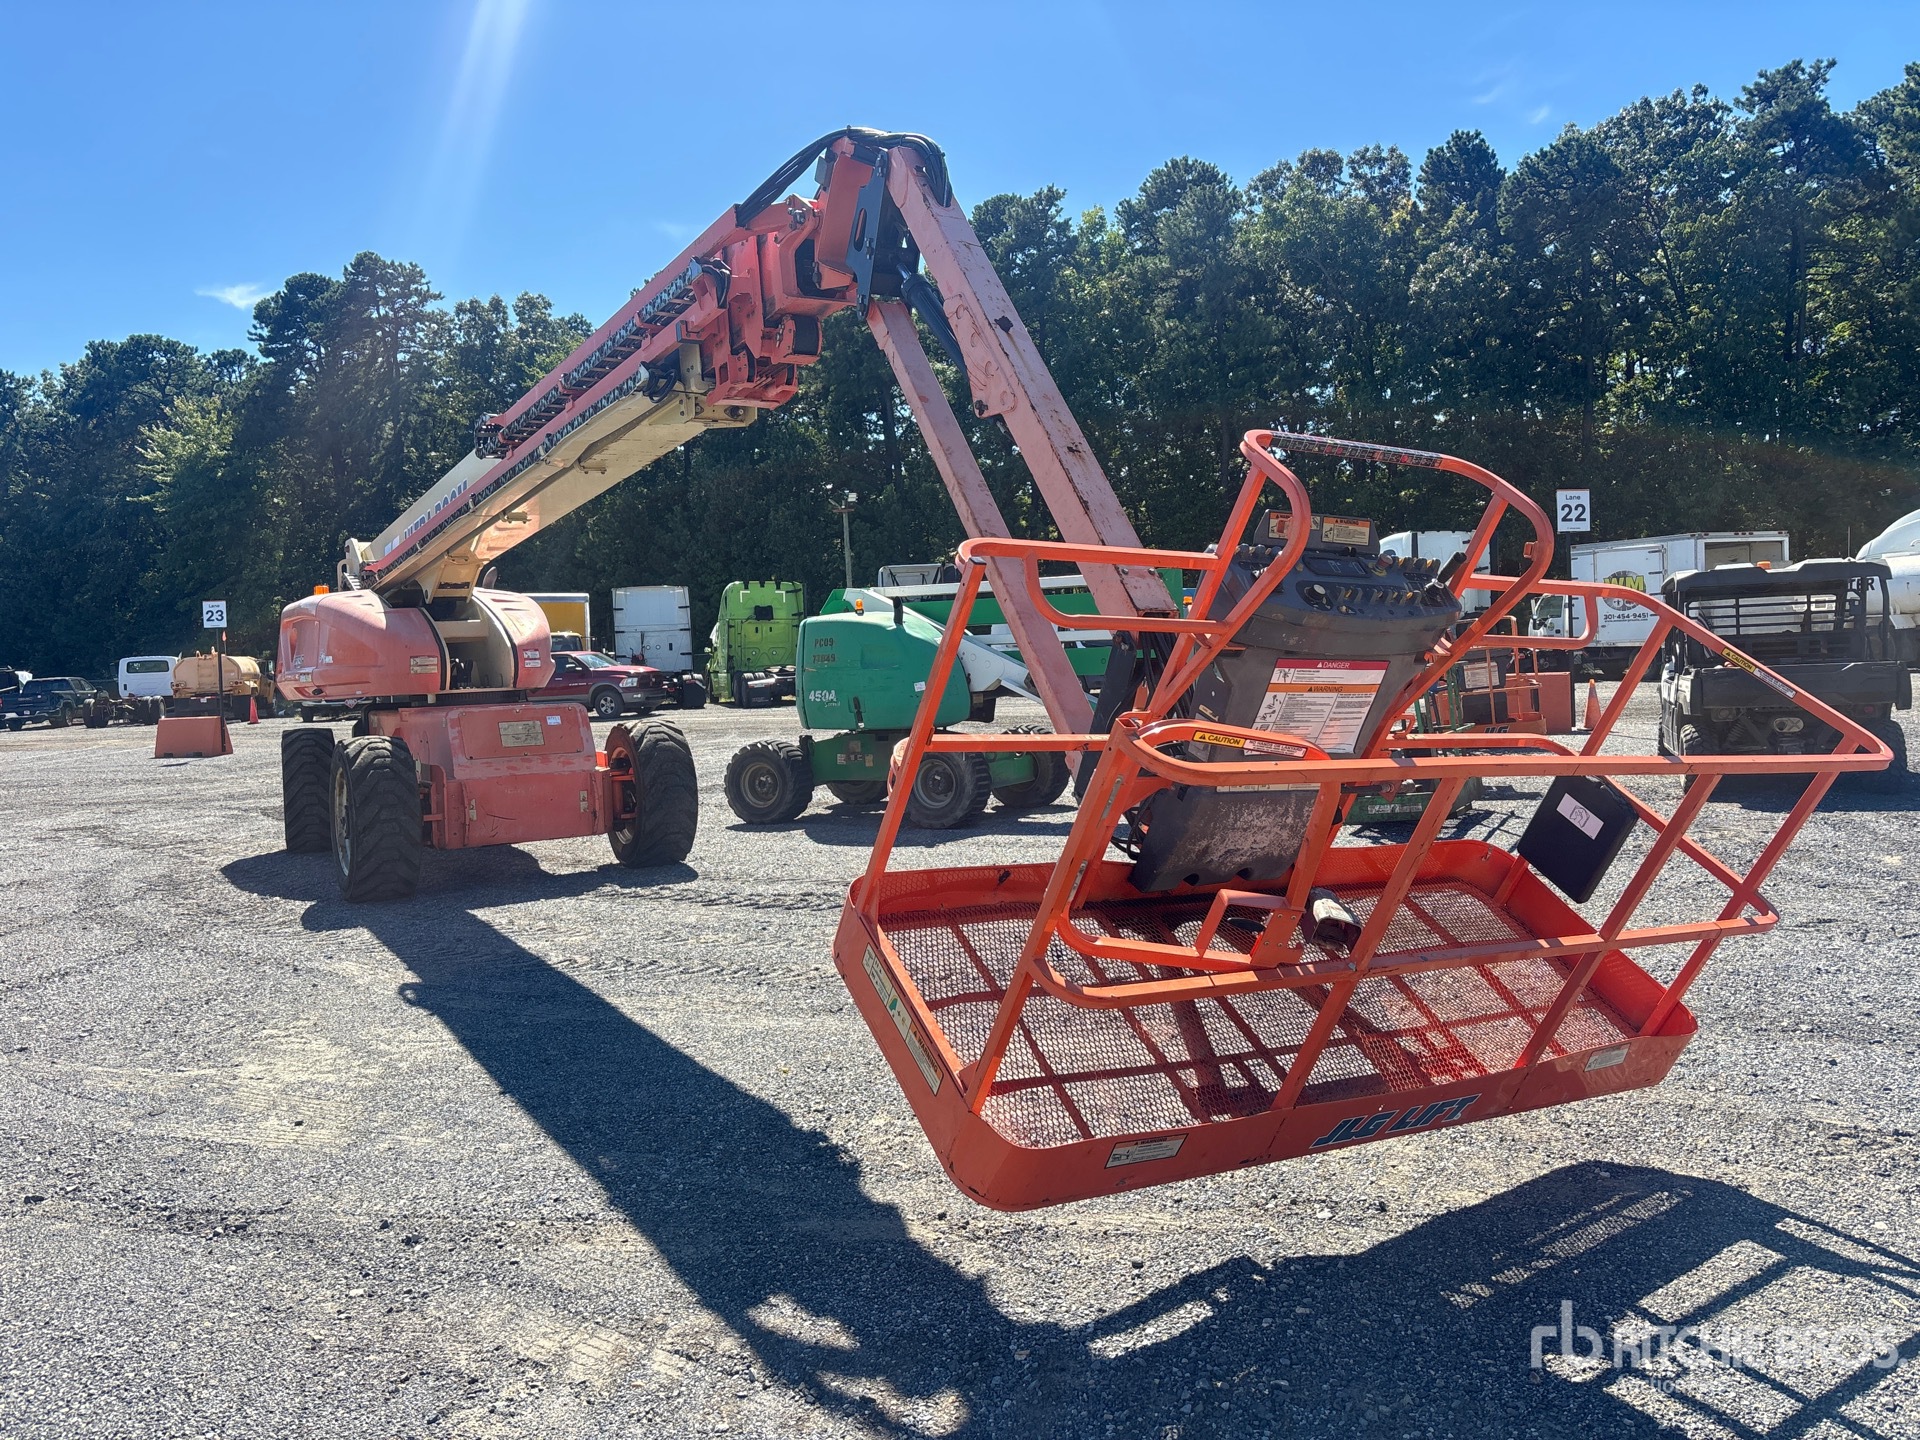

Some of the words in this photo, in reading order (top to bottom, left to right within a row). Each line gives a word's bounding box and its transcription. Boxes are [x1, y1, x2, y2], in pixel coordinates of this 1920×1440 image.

[1561, 503, 1587, 522] 22
[206, 609, 224, 622] 23
[1603, 612, 1649, 620] 301-454-9451
[1322, 661, 1350, 669] DANGER
[1731, 653, 1752, 670] CAUTION
[809, 690, 837, 702] 450A
[1207, 734, 1241, 745] CAUTION
[1309, 1109, 1399, 1149] JLG
[1385, 1093, 1482, 1133] LIFT
